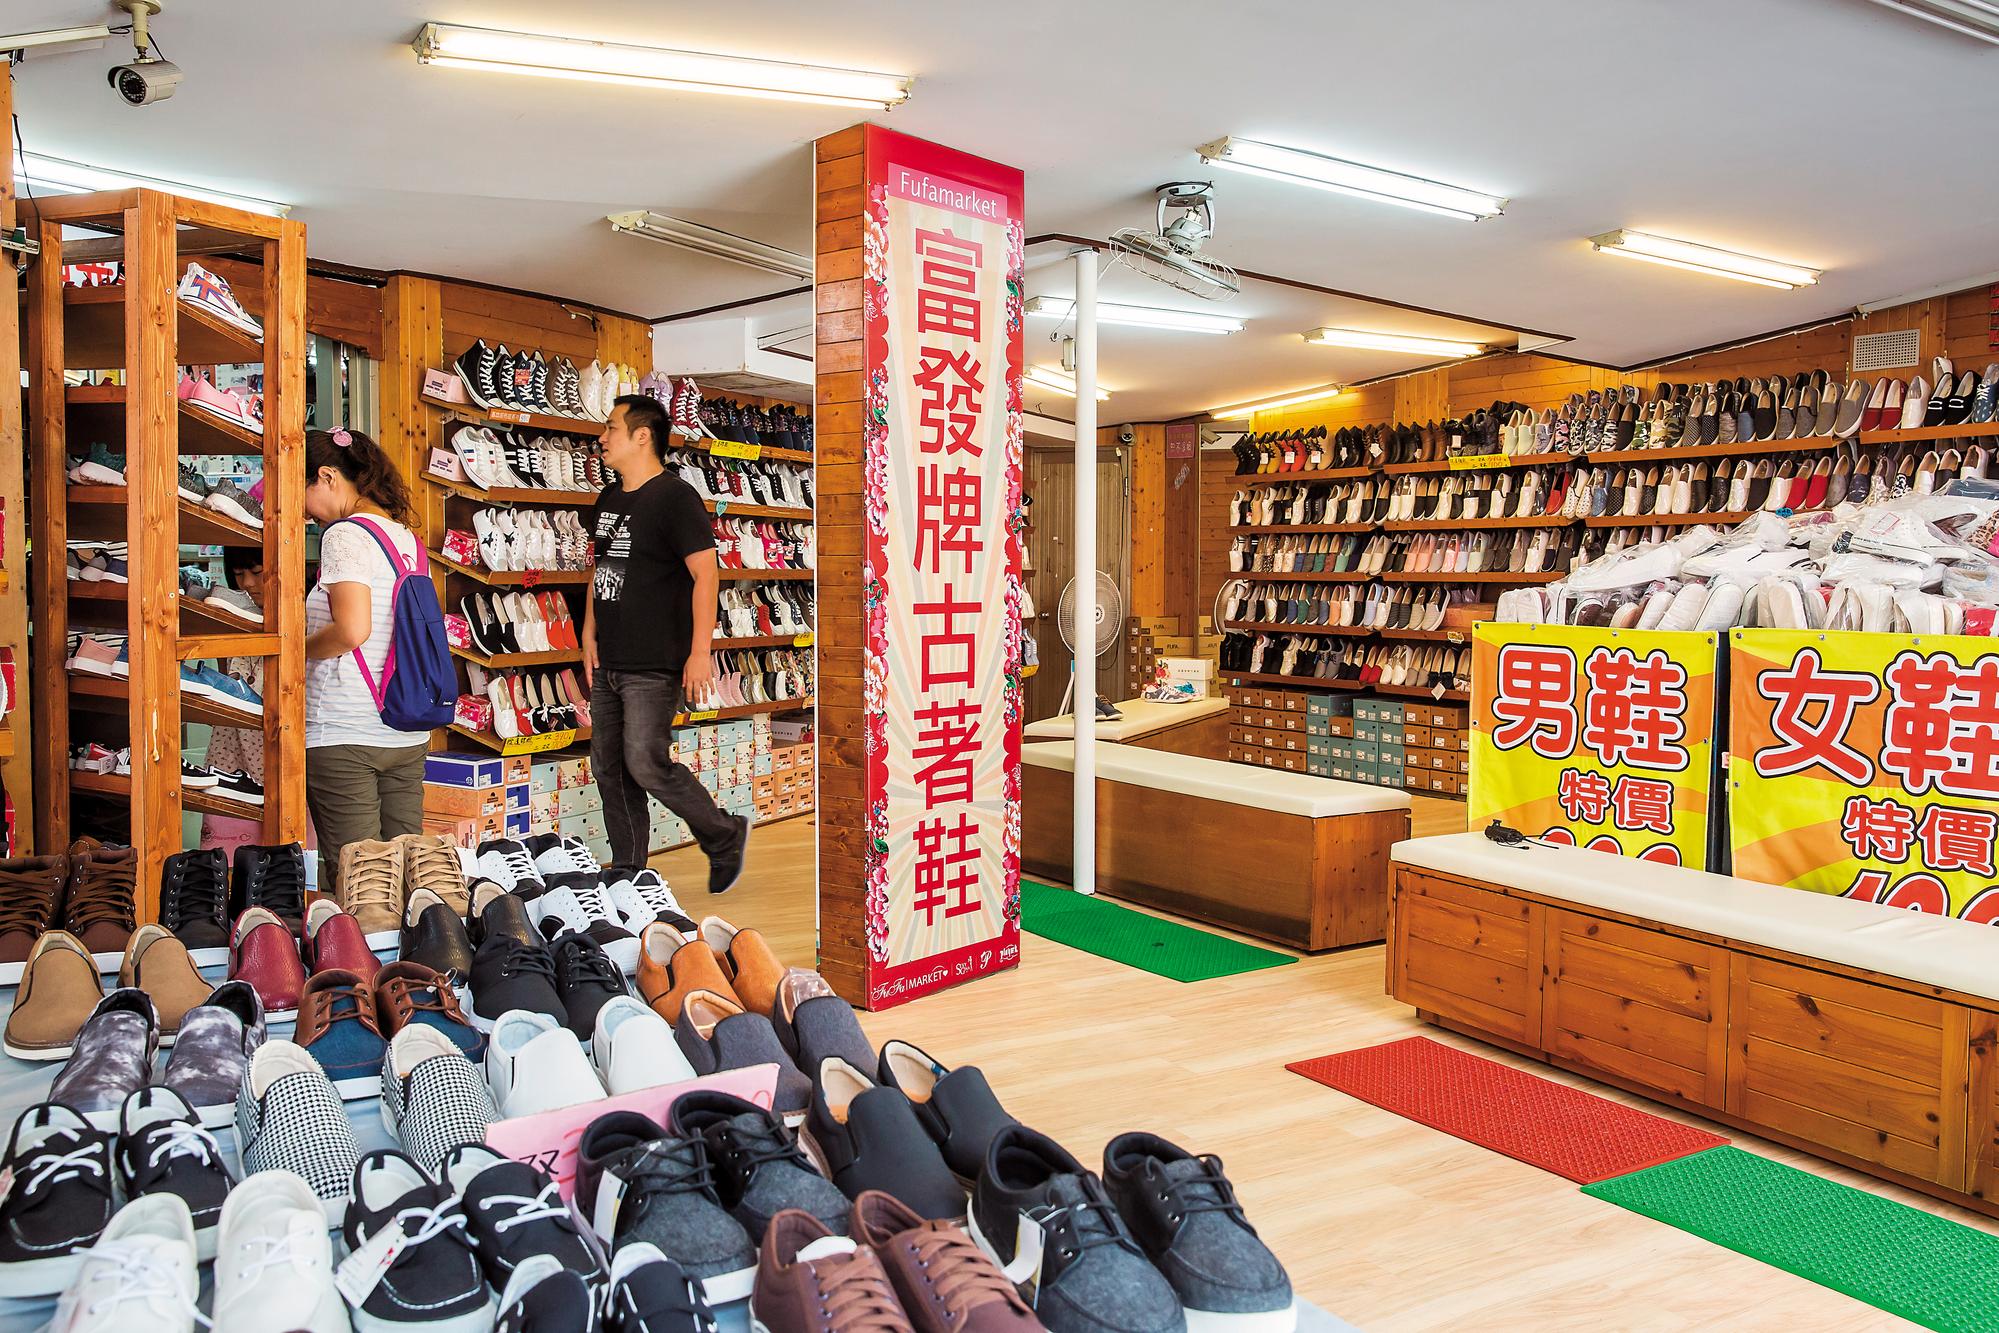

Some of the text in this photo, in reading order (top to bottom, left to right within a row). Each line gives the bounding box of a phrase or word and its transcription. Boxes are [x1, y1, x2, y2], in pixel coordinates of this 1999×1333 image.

[901, 171, 997, 218] Fufamarket
[912, 227, 985, 927] 富發牌古著鞋
[1491, 643, 1690, 771] 男鞋
[1754, 647, 1999, 802] 女鞋
[1558, 767, 1674, 835] 特價
[1841, 795, 1998, 879] 特價
[908, 970, 943, 989] MARKET
